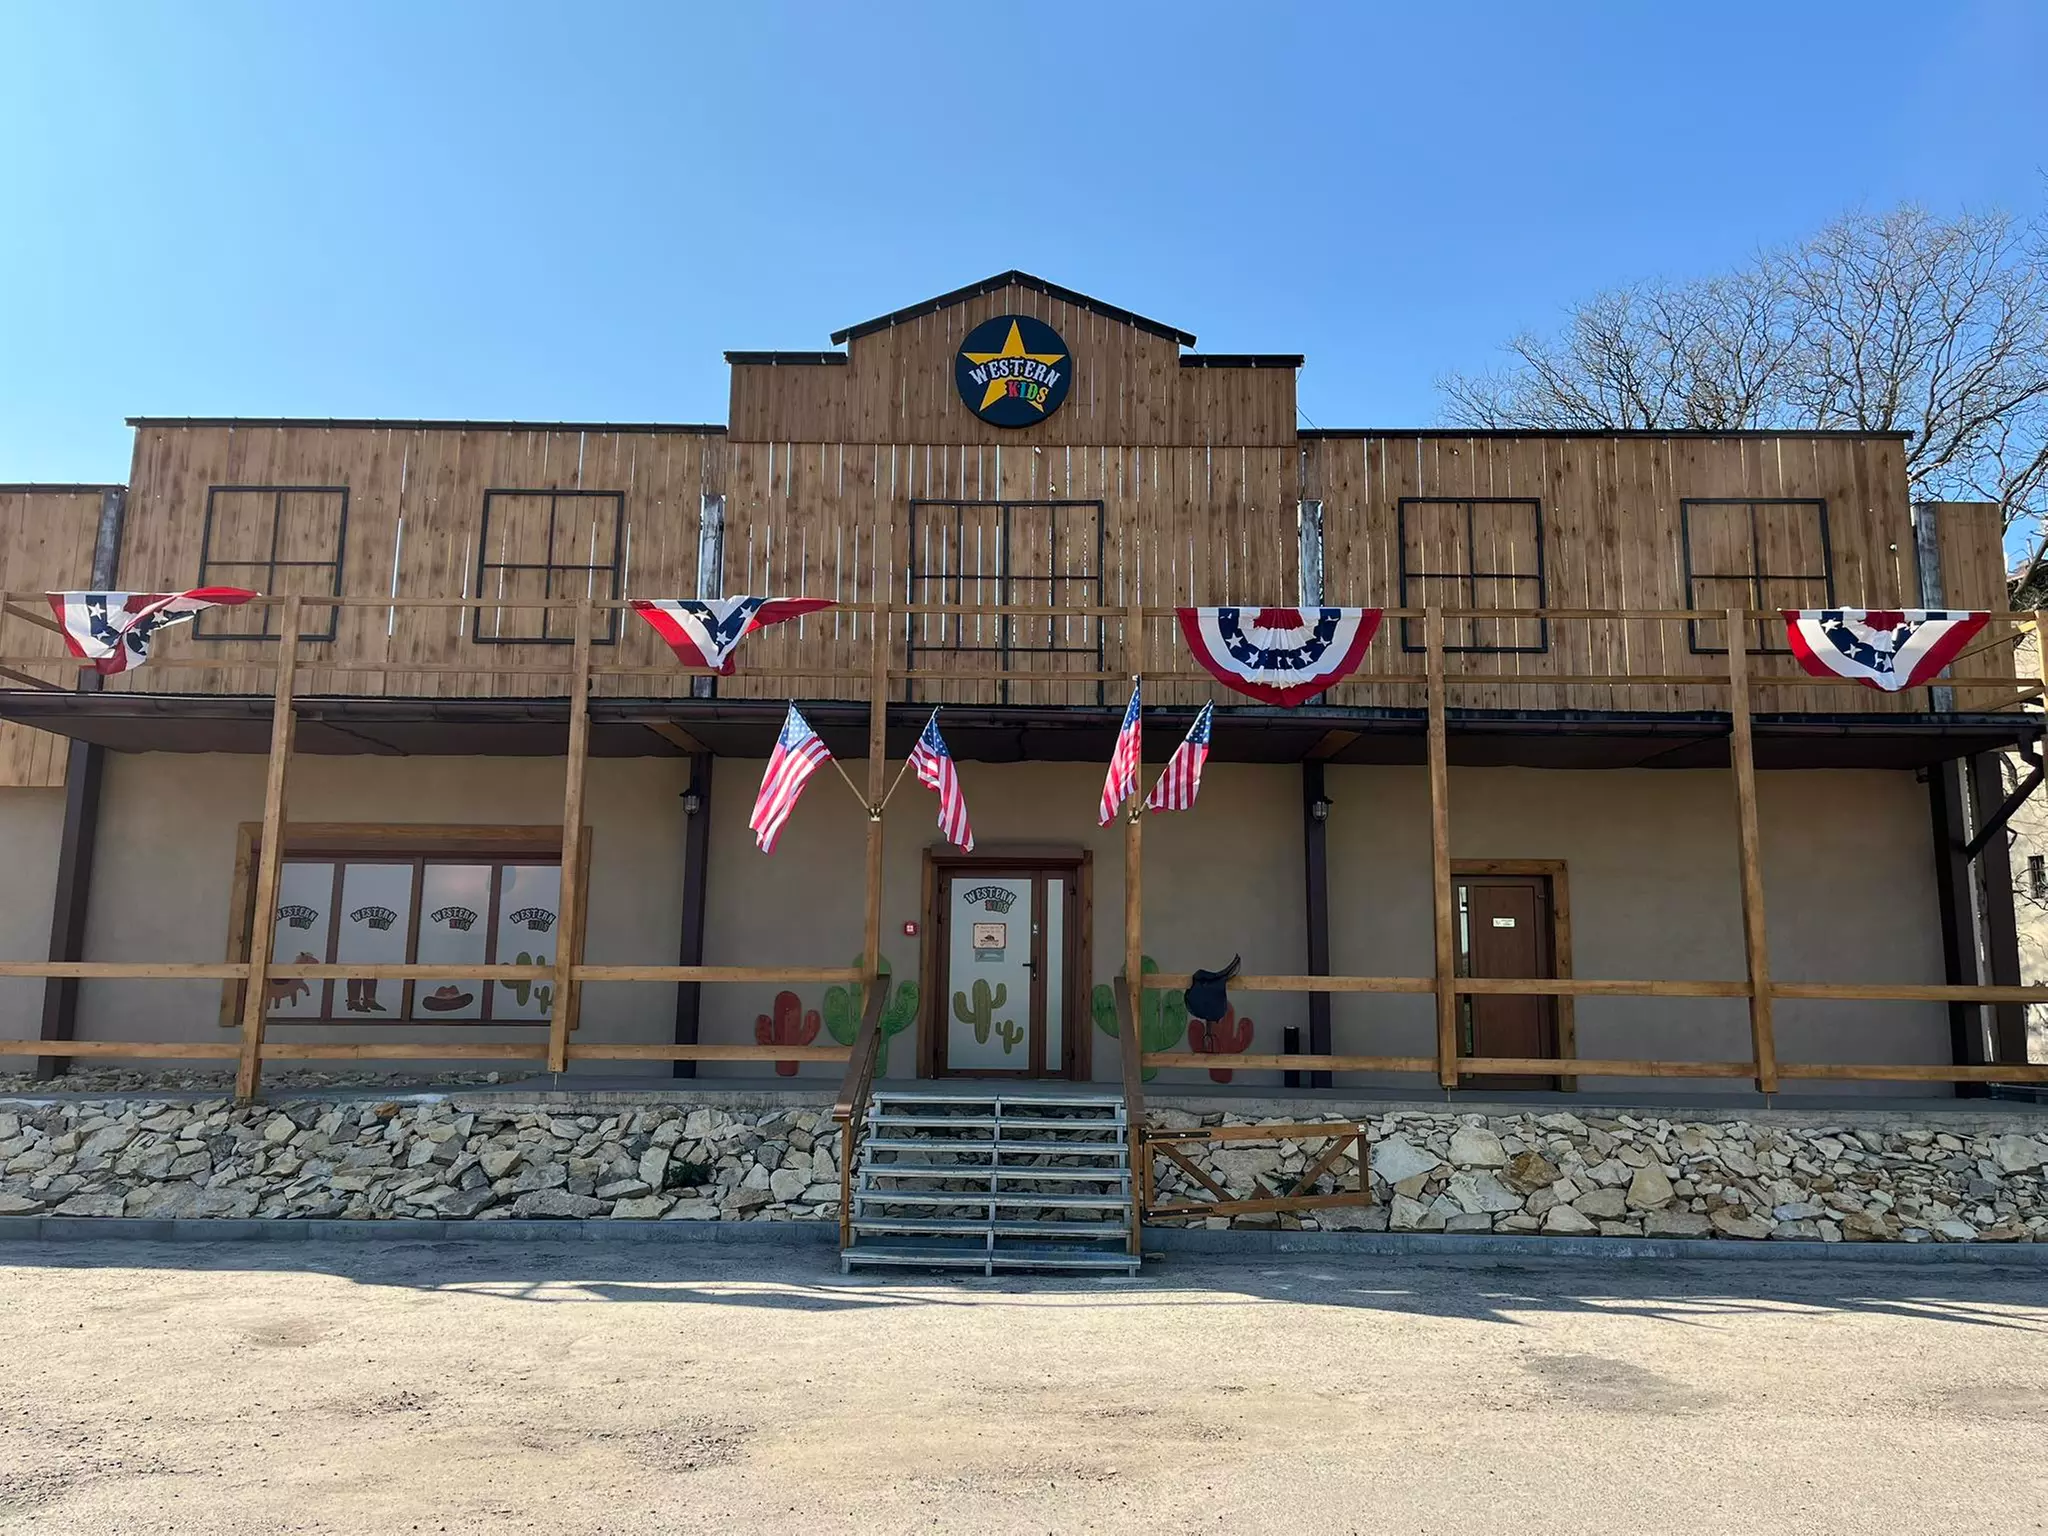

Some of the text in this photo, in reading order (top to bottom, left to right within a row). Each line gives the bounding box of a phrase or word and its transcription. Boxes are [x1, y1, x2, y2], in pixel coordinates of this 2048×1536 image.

[969, 359, 1061, 388] WESTERN
[1007, 381, 1049, 403] KIDS
[964, 887, 1015, 904] WESTERN
[351, 907, 397, 922] WESTERN
[431, 907, 477, 922] WESTERN
[510, 908, 556, 923] WESTERN
